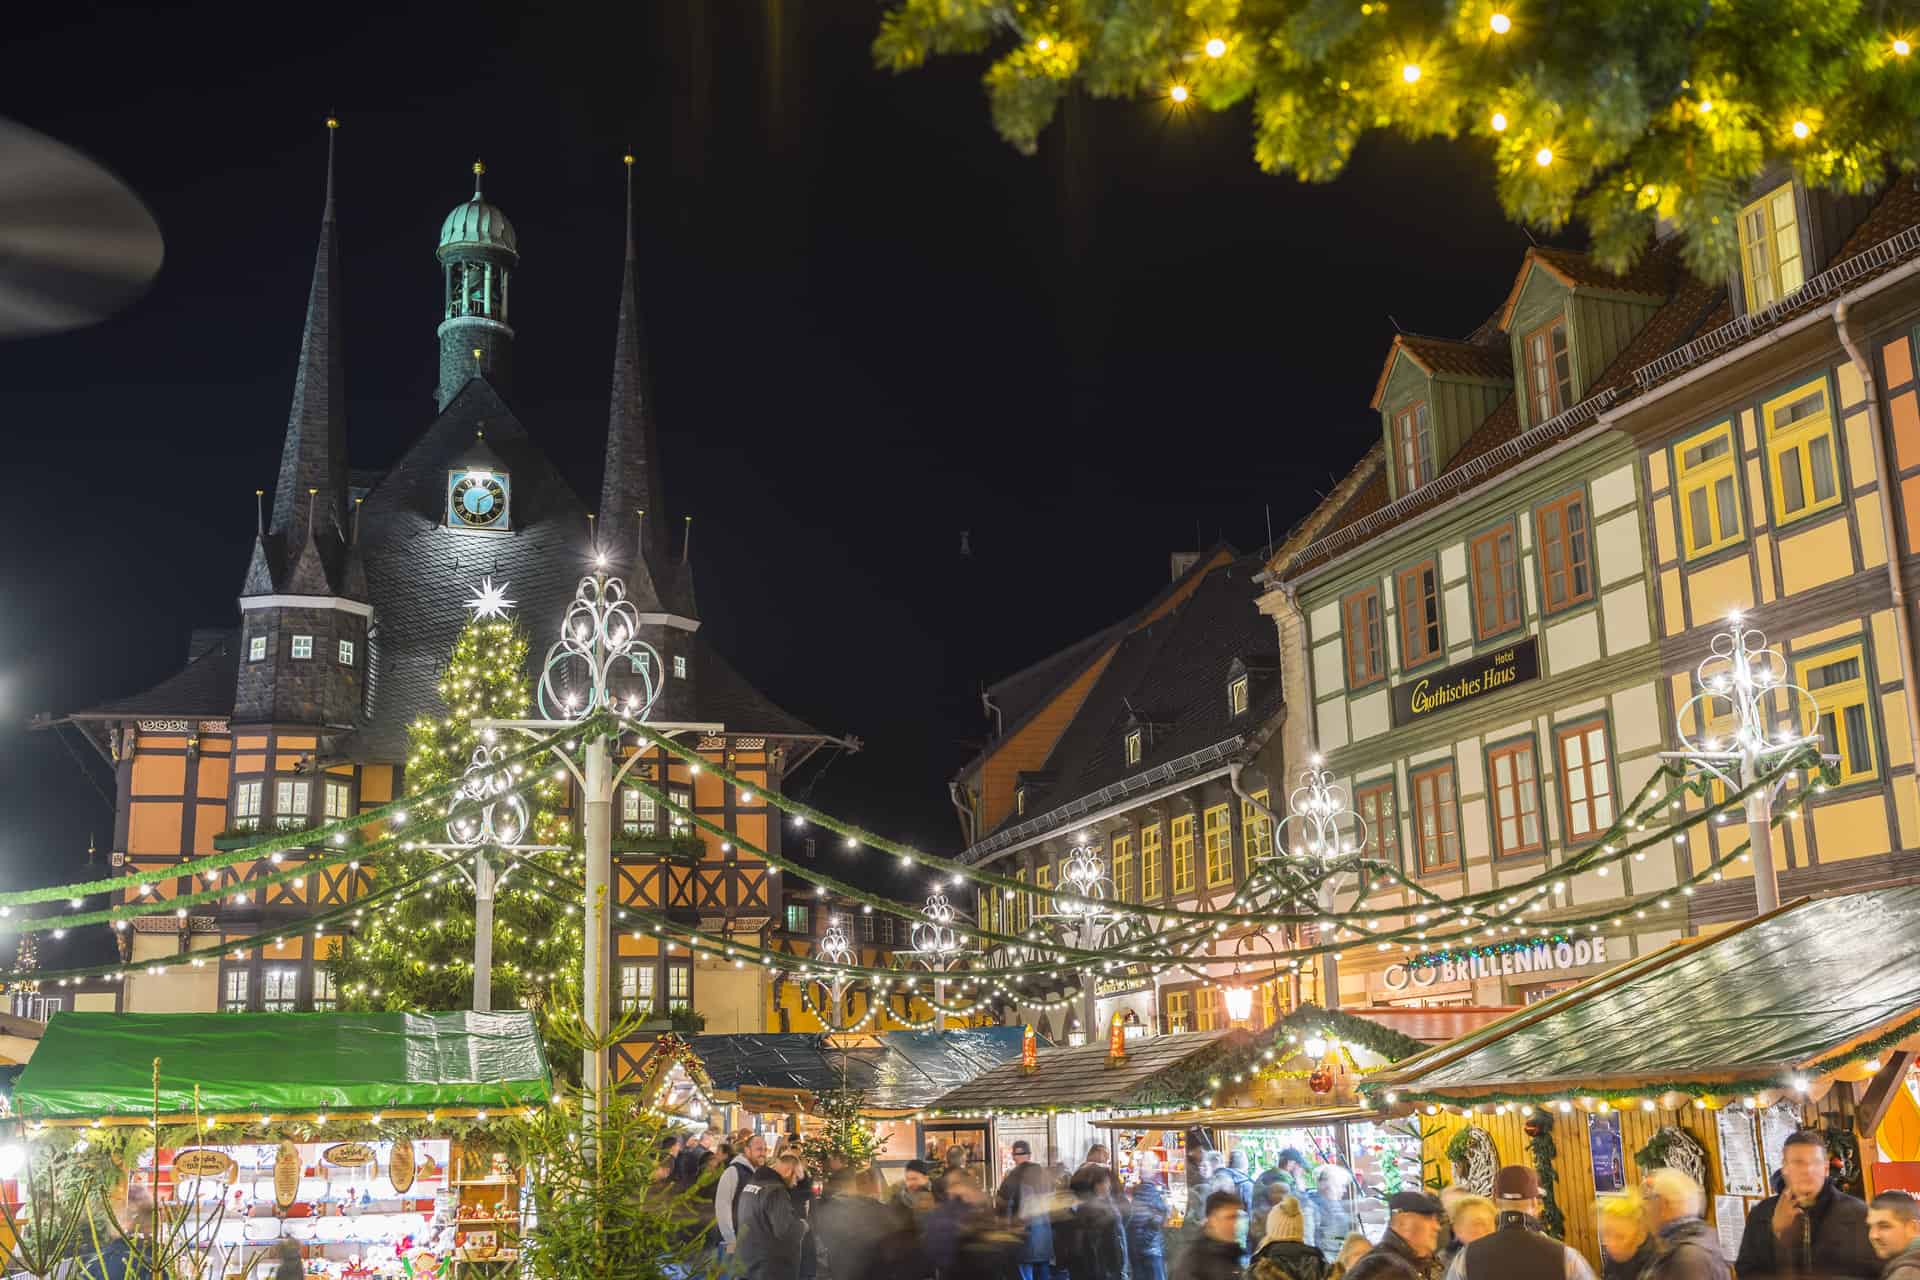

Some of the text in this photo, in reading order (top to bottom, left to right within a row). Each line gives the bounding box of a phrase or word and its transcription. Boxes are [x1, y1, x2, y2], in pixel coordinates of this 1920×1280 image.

[1494, 649, 1514, 665] Hotel
[1411, 666, 1516, 713] Gothisches Haus
[1441, 936, 1607, 982] BRILLENMODE
